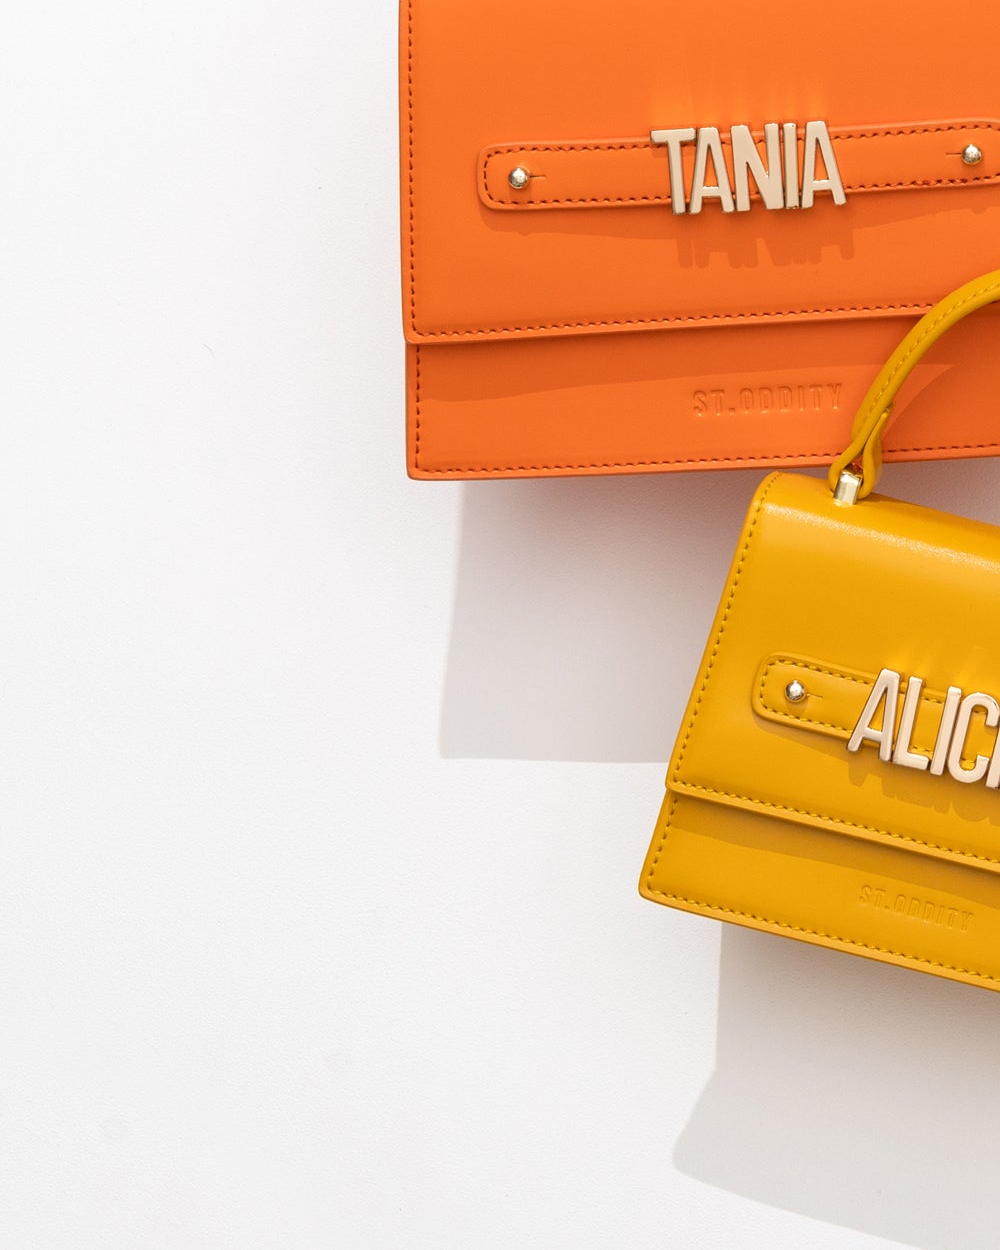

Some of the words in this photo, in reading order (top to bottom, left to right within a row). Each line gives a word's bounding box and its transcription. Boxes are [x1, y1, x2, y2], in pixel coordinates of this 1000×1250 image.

[649, 119, 848, 216] TANIA
[692, 382, 843, 417] ST.ODDITY
[858, 884, 975, 933] ST.ODDITY
